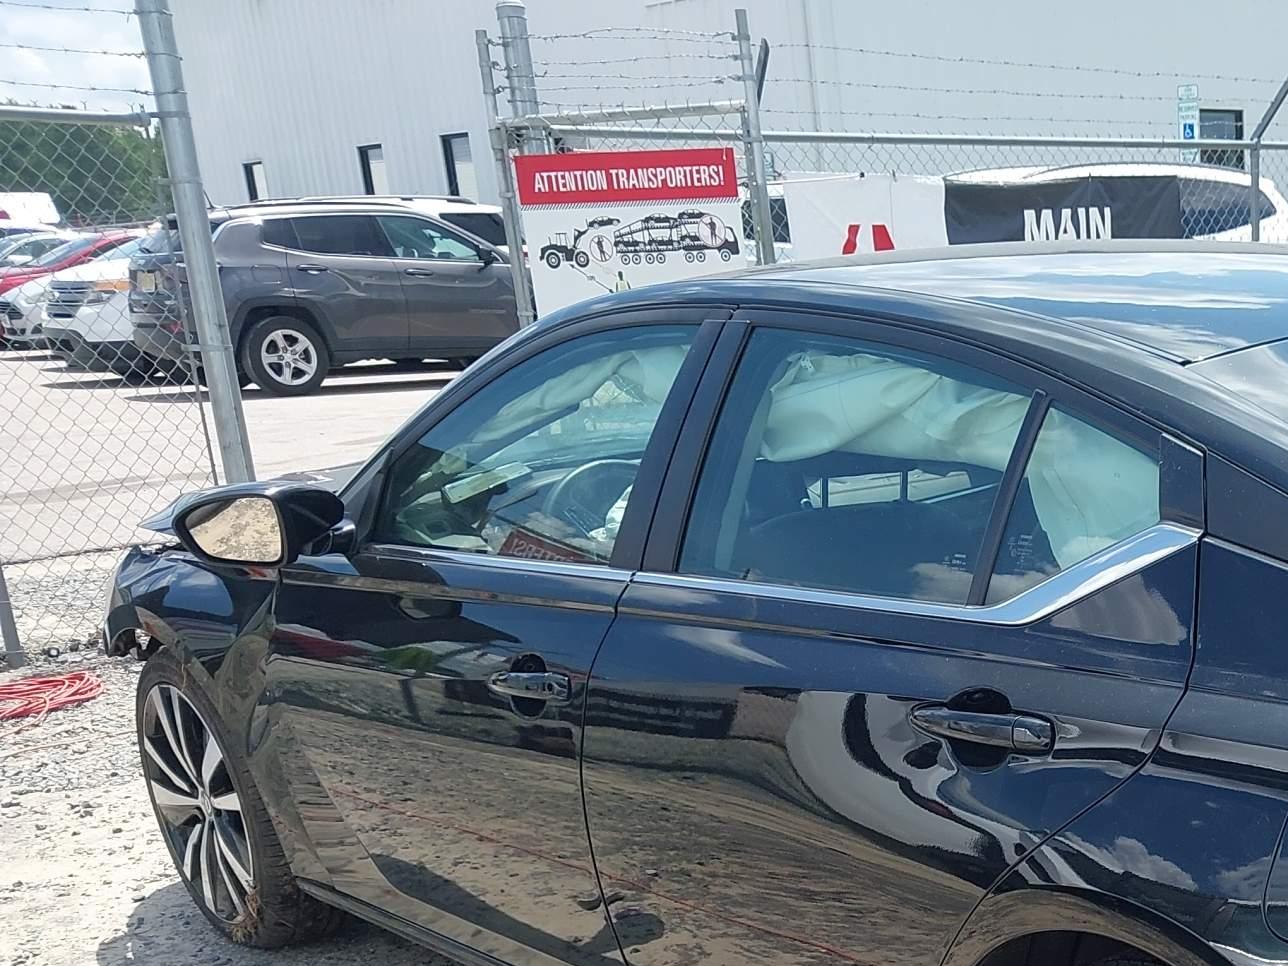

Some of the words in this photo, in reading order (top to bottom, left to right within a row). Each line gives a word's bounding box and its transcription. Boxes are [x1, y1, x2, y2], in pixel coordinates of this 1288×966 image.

[534, 169, 608, 193] ATTENTION
[609, 165, 725, 191] TRANSPORTERS!
[1023, 206, 1113, 241] MAIN
